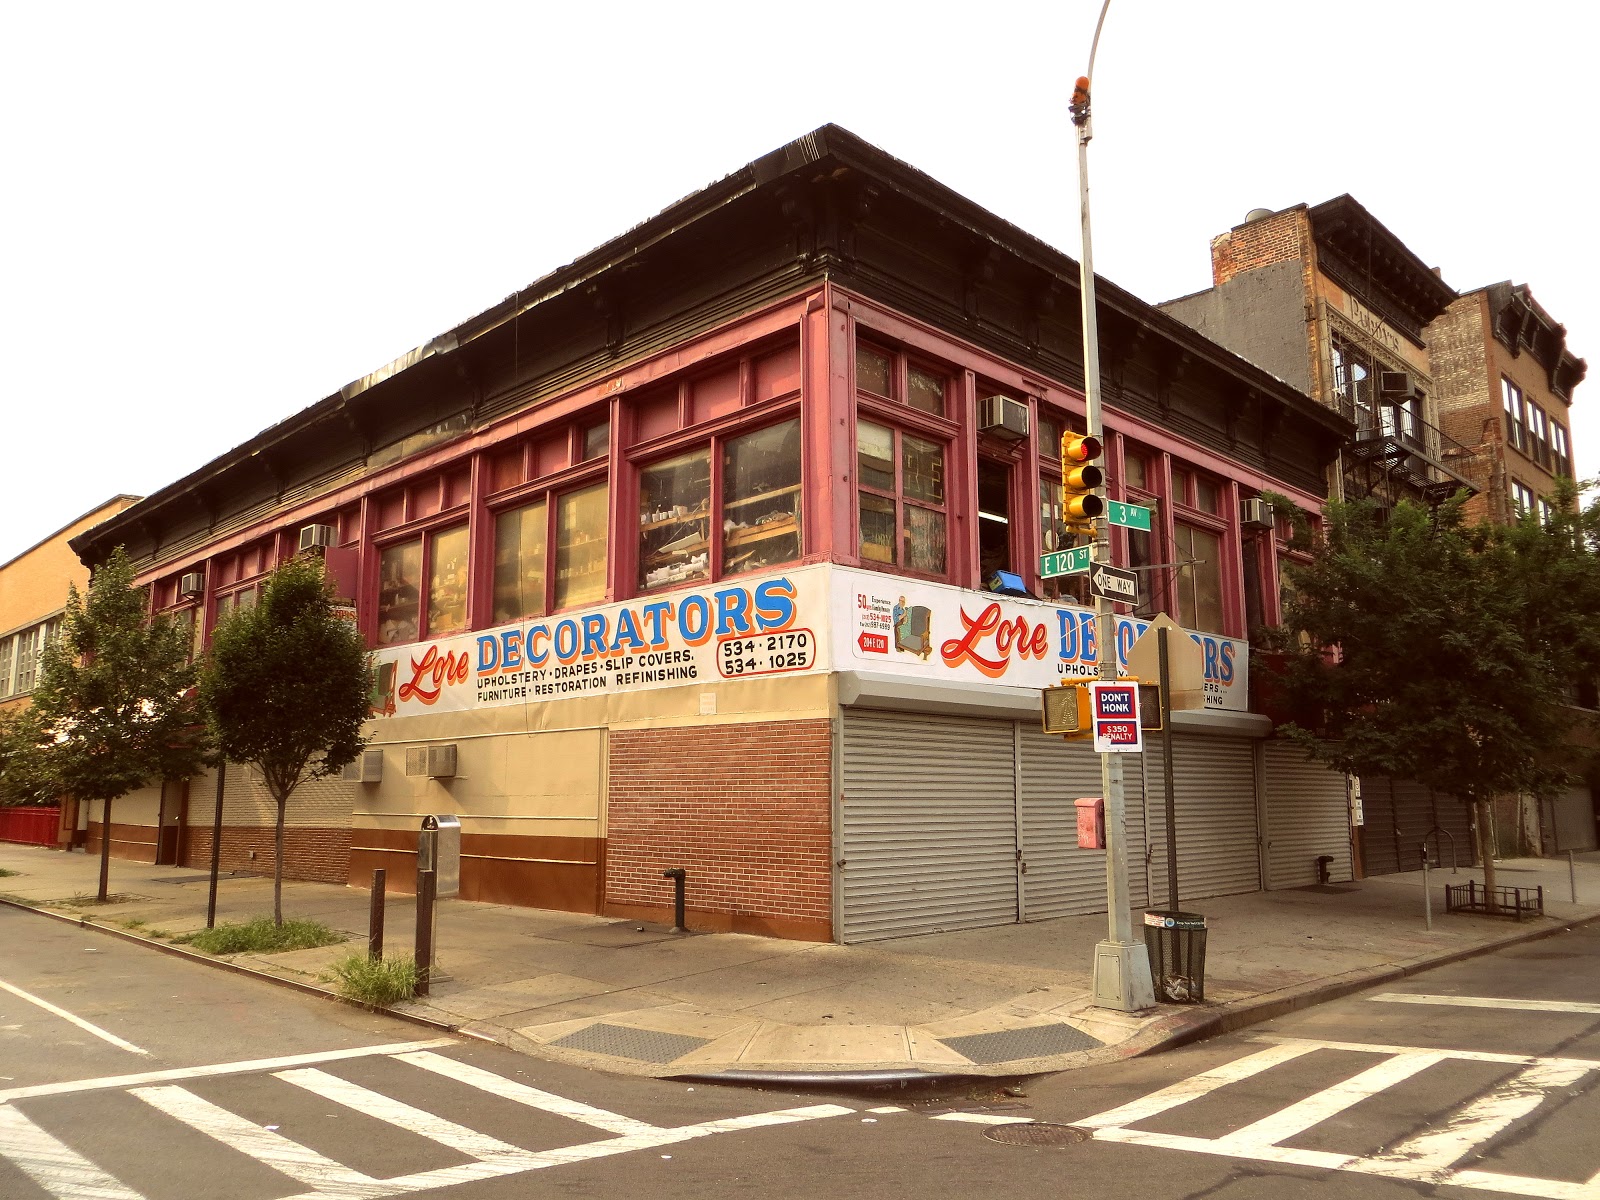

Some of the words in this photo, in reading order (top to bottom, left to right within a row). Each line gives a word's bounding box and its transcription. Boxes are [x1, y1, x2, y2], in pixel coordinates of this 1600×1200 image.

[1119, 505, 1127, 524] 3
[1130, 508, 1138, 518] AV
[1044, 556, 1052, 575] E
[1056, 551, 1075, 573] 120
[1079, 549, 1088, 560] ST
[1097, 573, 1111, 589] ONE
[1116, 578, 1132, 595] WAY
[857, 593, 867, 609] 50
[399, 644, 470, 706] Lore
[476, 576, 798, 677] DECORATORS
[876, 638, 885, 649] 120
[940, 602, 1049, 679] Lore
[477, 669, 547, 689] UPHOLSTERY
[554, 661, 598, 679] DRAPES
[605, 656, 634, 671] SLIP
[477, 686, 527, 702] FURNITURE
[535, 675, 607, 696] RESTORATION
[616, 665, 698, 686] REFINISHING
[1100, 692, 1129, 702] DON'T
[1102, 703, 1130, 713] HONK
[1102, 732, 1133, 741] PENALTY
[1106, 725, 1128, 733] $350
